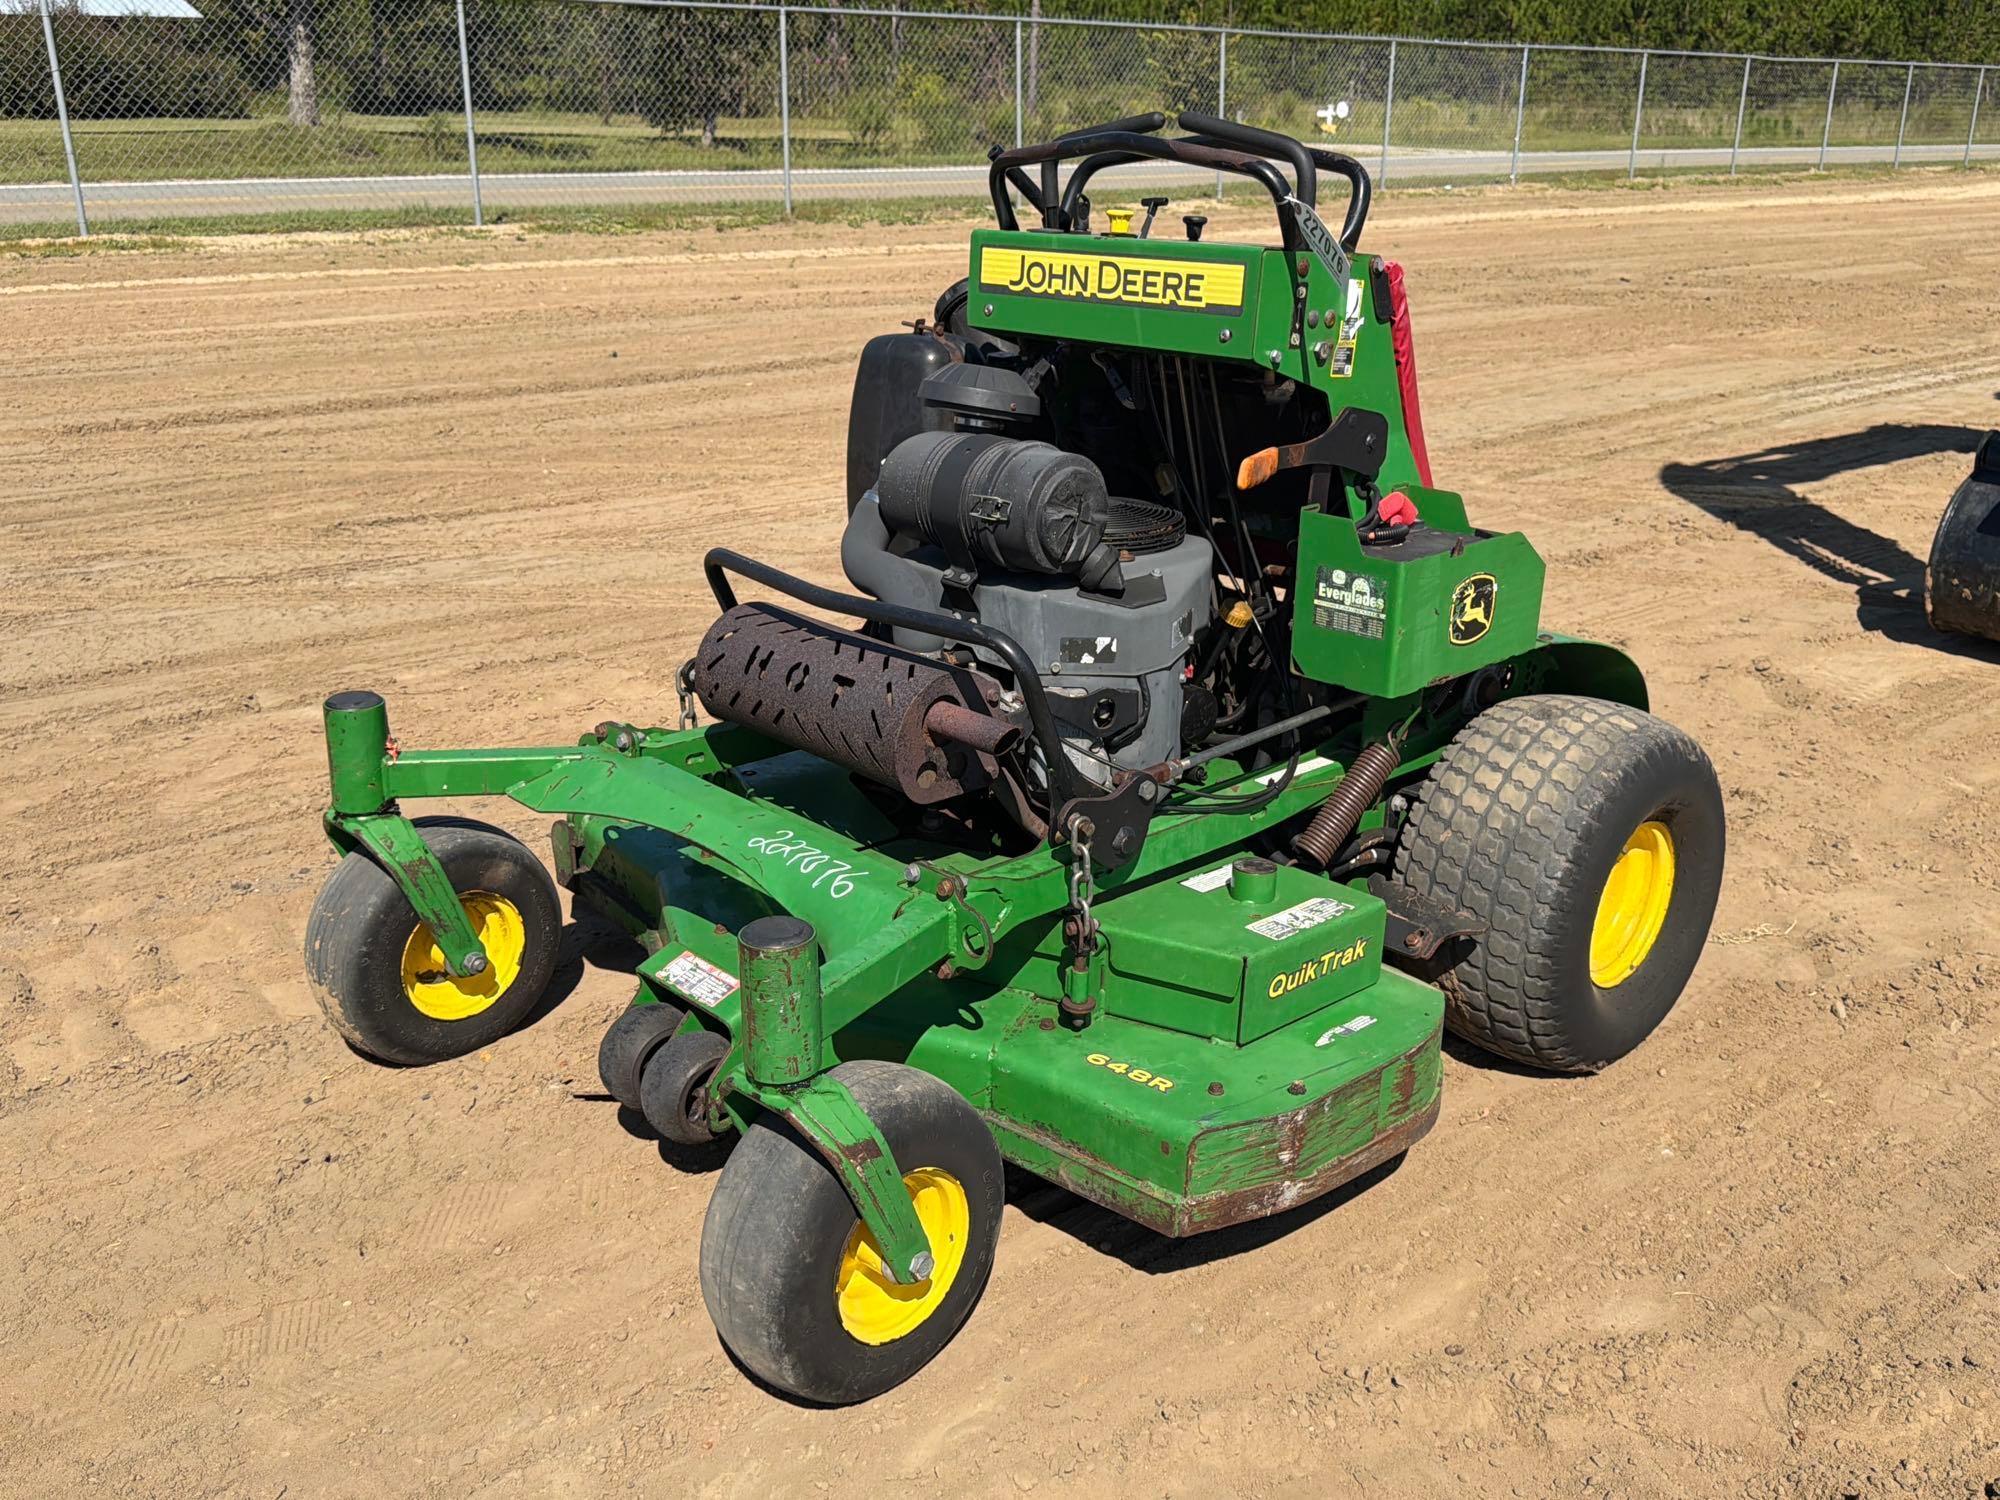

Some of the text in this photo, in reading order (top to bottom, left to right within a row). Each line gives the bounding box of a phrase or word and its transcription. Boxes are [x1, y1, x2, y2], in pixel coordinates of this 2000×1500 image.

[1302, 209, 1344, 274] 227076
[1009, 254, 1205, 302] JOHN DEERE
[1318, 580, 1385, 610] Everglades
[744, 645, 856, 709] HOT
[747, 830, 870, 899] 227076
[1267, 937, 1368, 1000] QuikTrak
[1085, 1052, 1175, 1093] 648R
